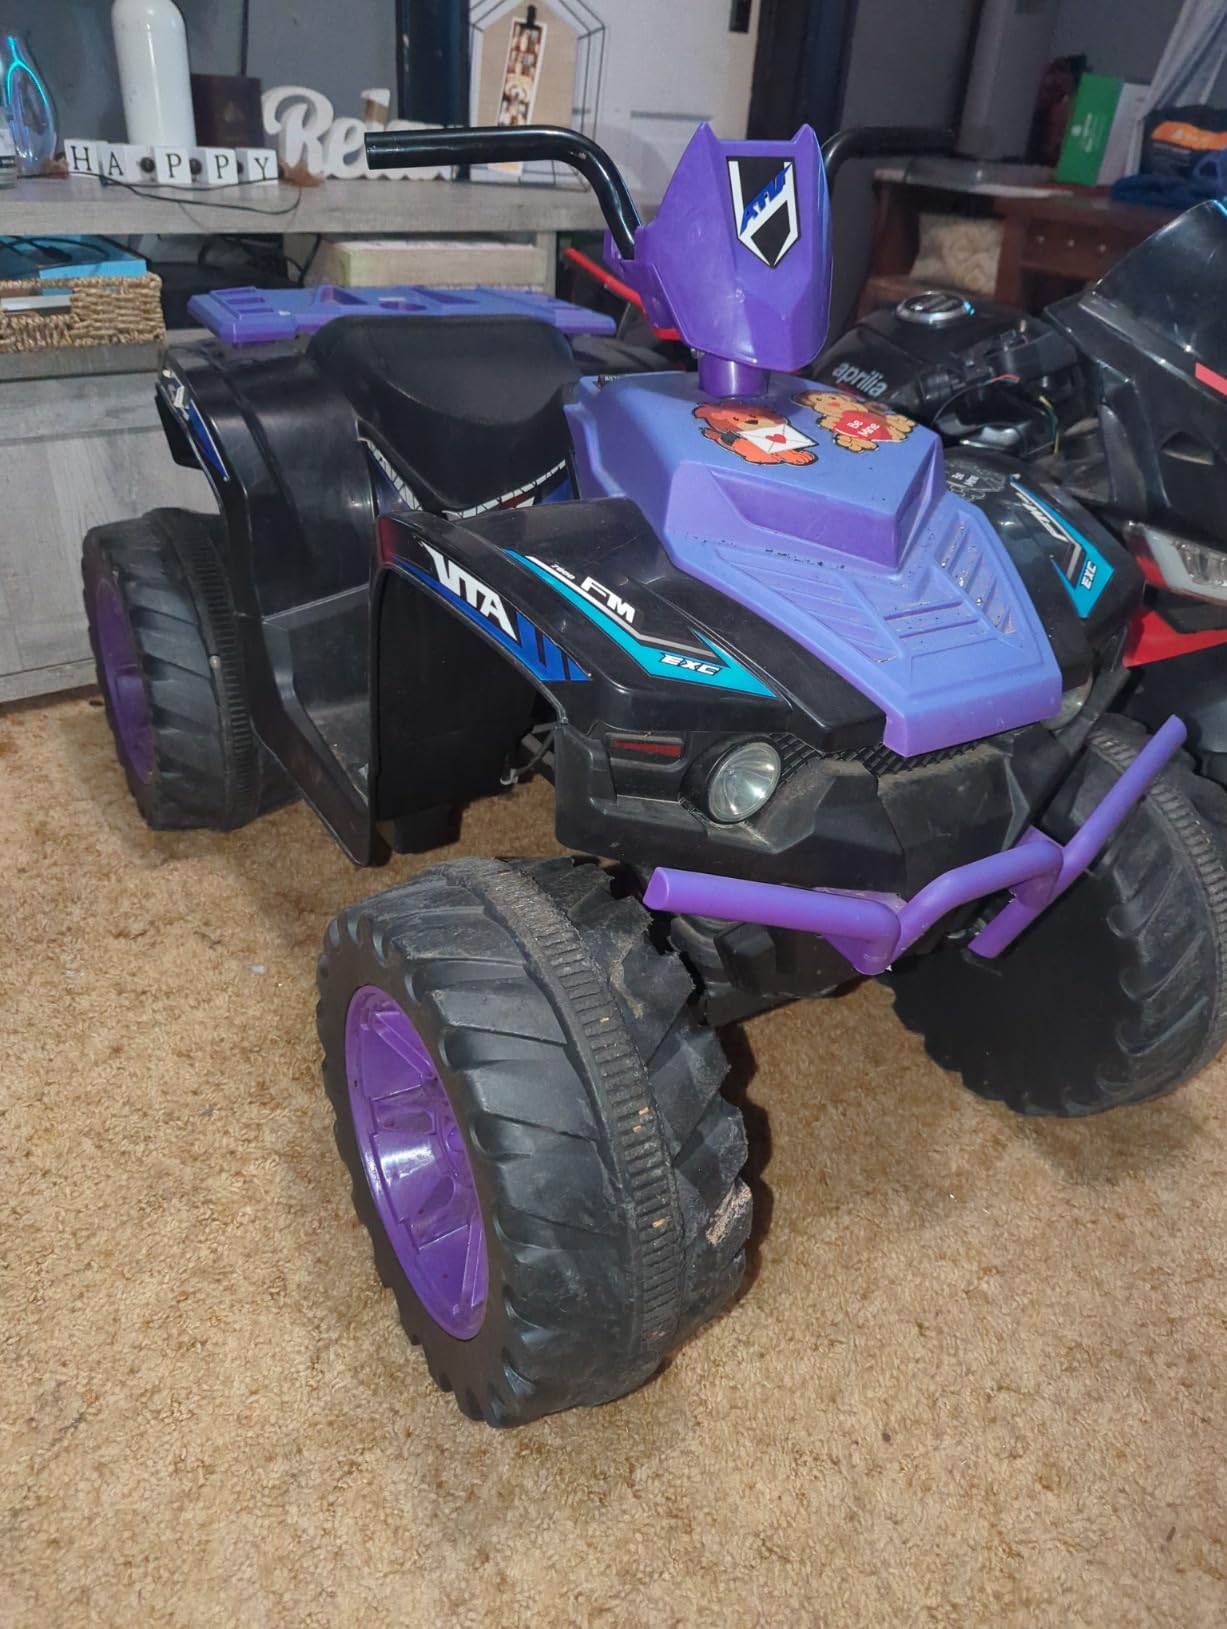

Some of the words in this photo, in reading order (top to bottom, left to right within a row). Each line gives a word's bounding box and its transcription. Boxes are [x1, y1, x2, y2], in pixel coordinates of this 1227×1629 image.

[70, 146, 269, 180] HAPPY
[740, 162, 793, 236] ATV
[832, 363, 888, 398] aprilia
[1081, 560, 1096, 590] EXC
[580, 576, 636, 624] FM
[660, 653, 720, 675] EXC
